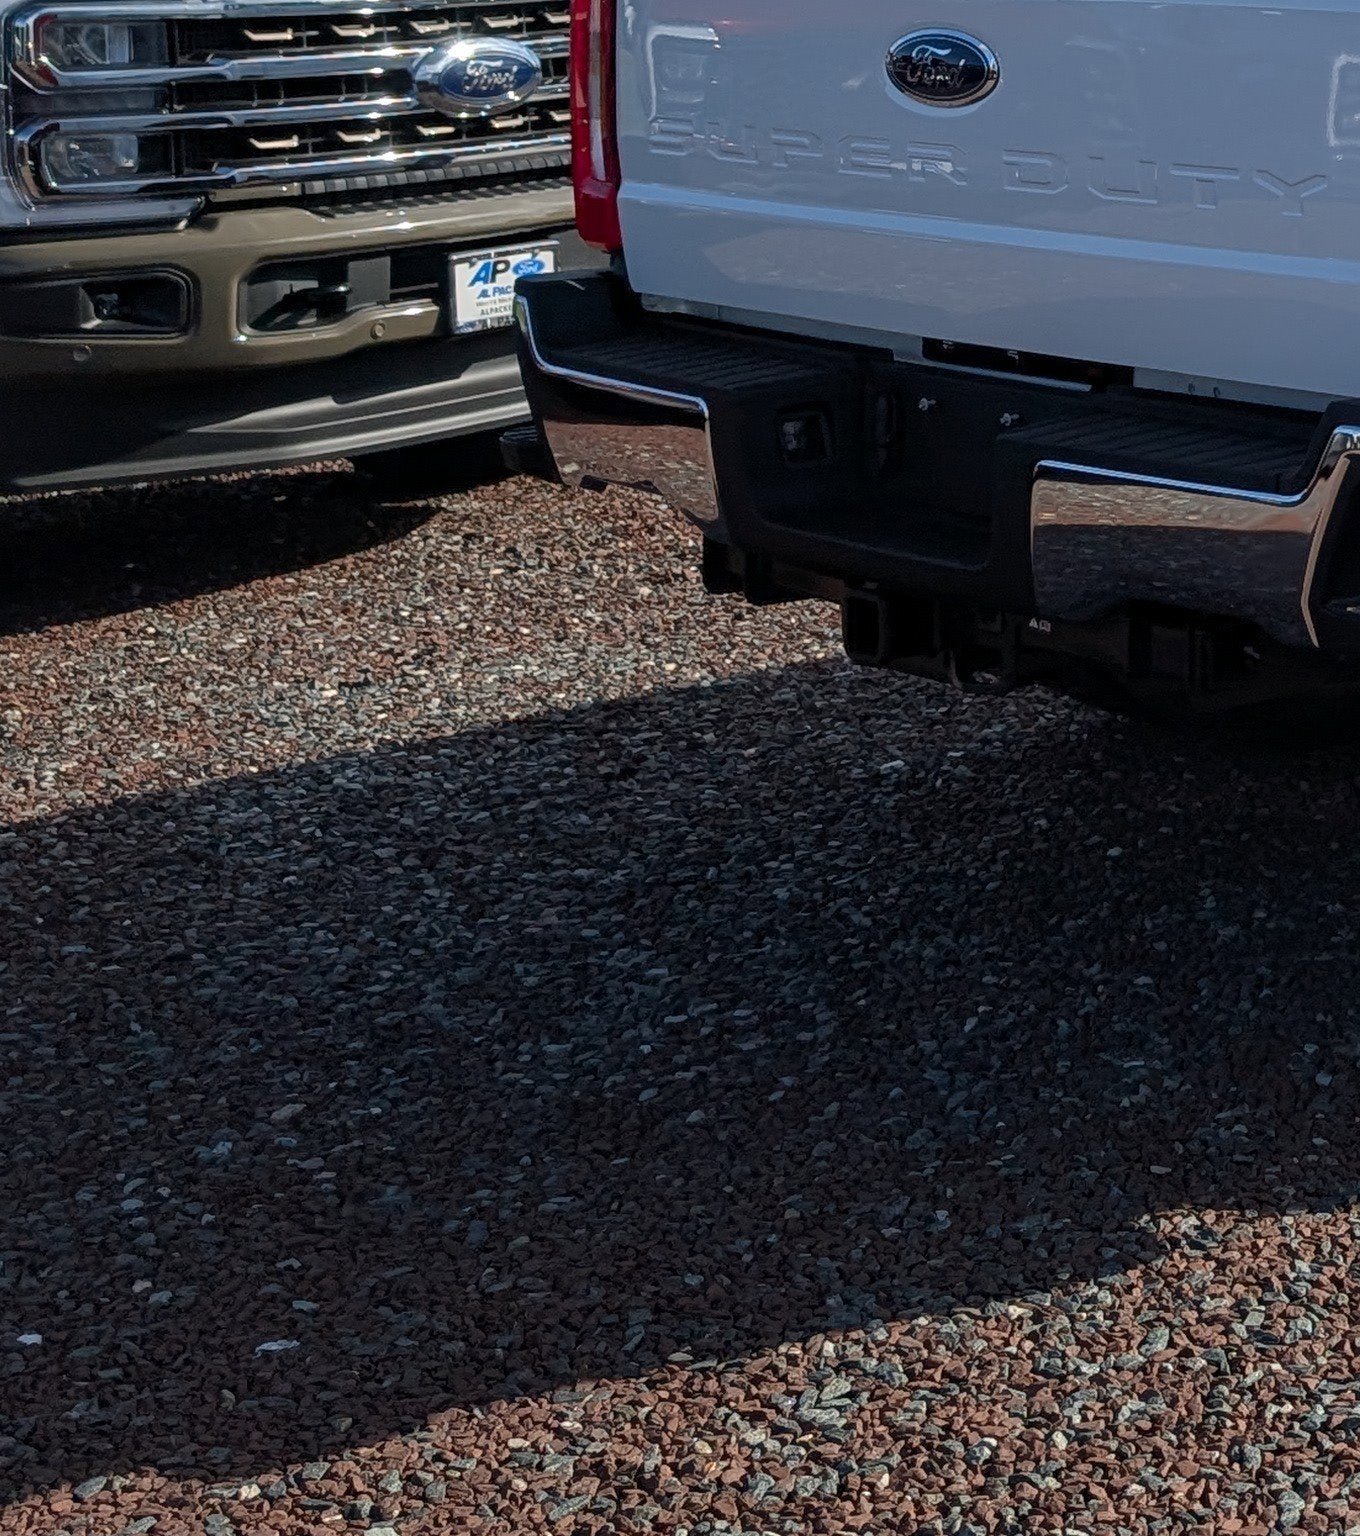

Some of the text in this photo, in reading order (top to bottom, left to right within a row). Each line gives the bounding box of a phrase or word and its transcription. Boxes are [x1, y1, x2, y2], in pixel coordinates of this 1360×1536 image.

[463, 59, 519, 94] Ford
[906, 44, 966, 88] Ford
[648, 115, 1328, 218] SUPER DUTY
[467, 259, 511, 288] AP
